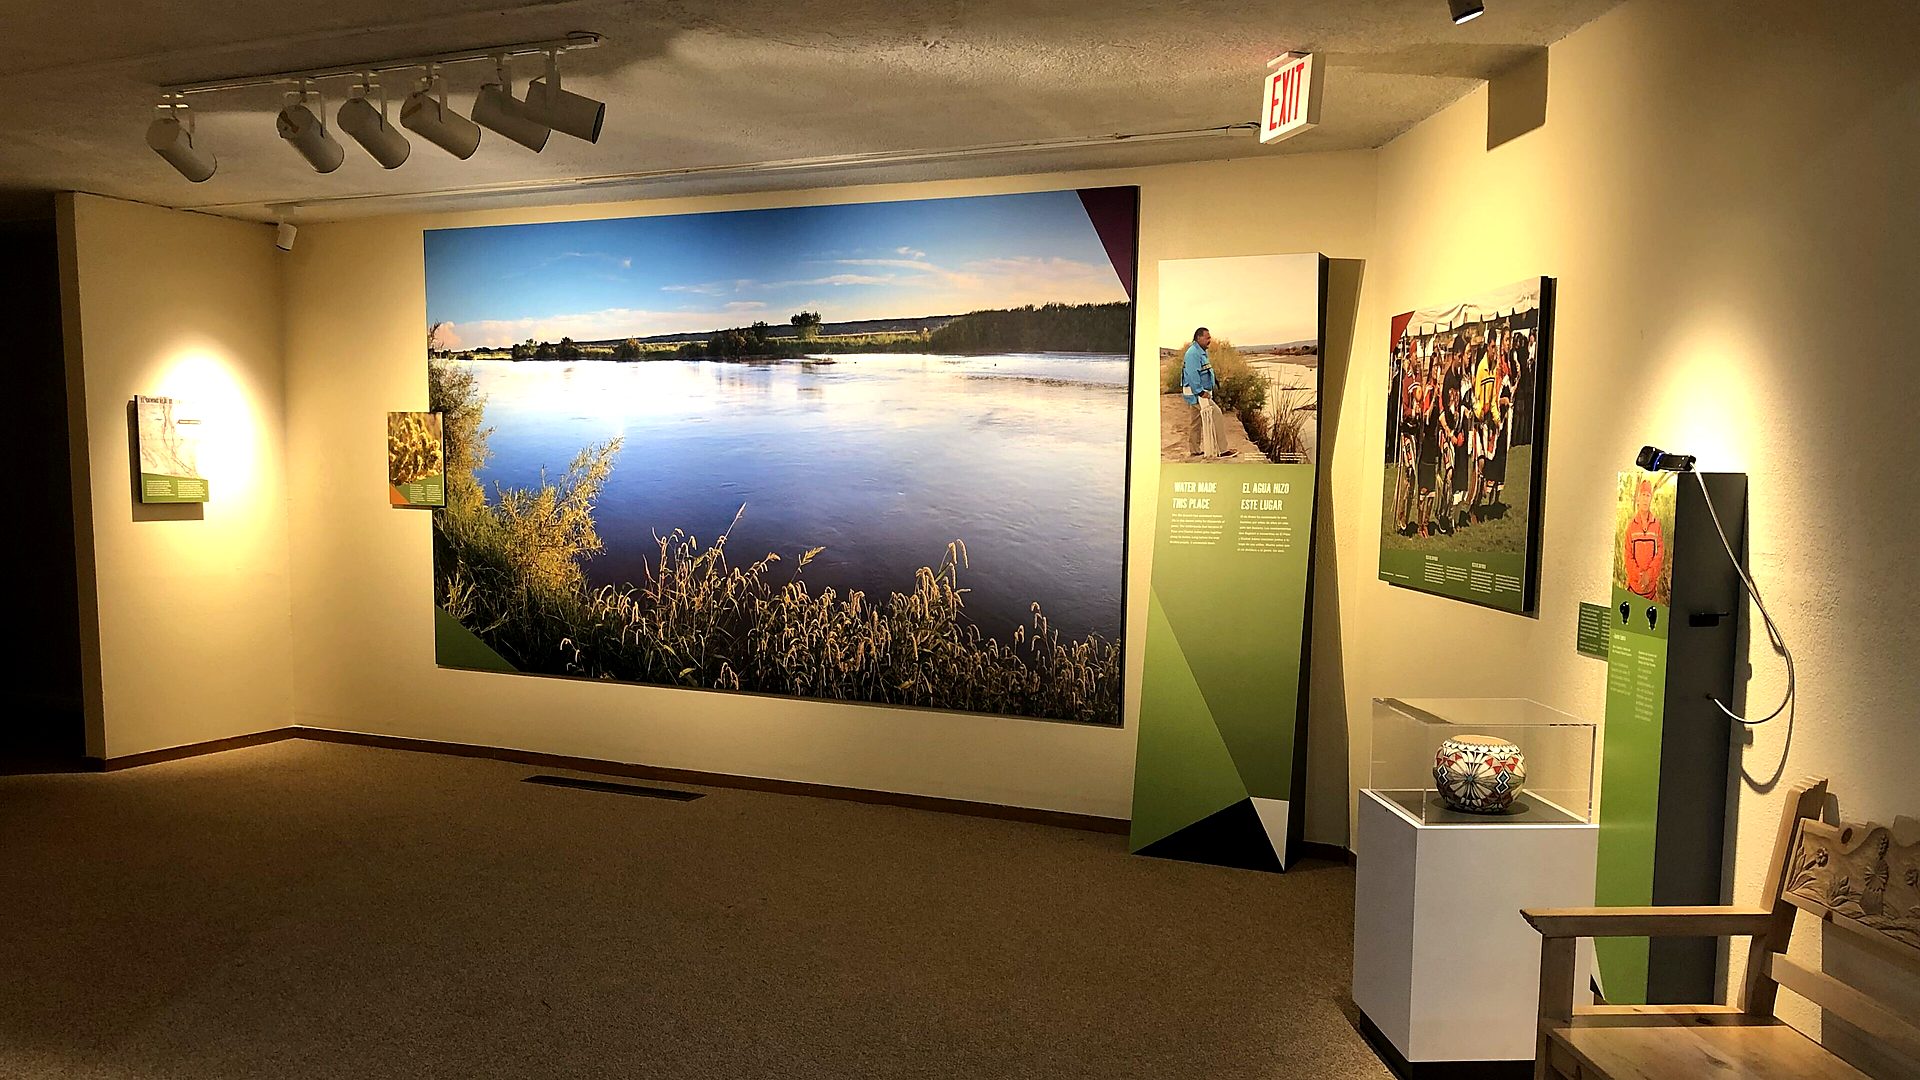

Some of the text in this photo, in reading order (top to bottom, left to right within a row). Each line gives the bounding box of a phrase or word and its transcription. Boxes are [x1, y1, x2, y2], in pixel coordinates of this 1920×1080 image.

[1269, 62, 1305, 131] EXIT
[1174, 481, 1217, 493] WATER MADE
[1242, 482, 1290, 494] EL AGUA HIZO
[1172, 497, 1211, 510] THIS PLACE
[1240, 499, 1283, 511] ESTE LUGAR
